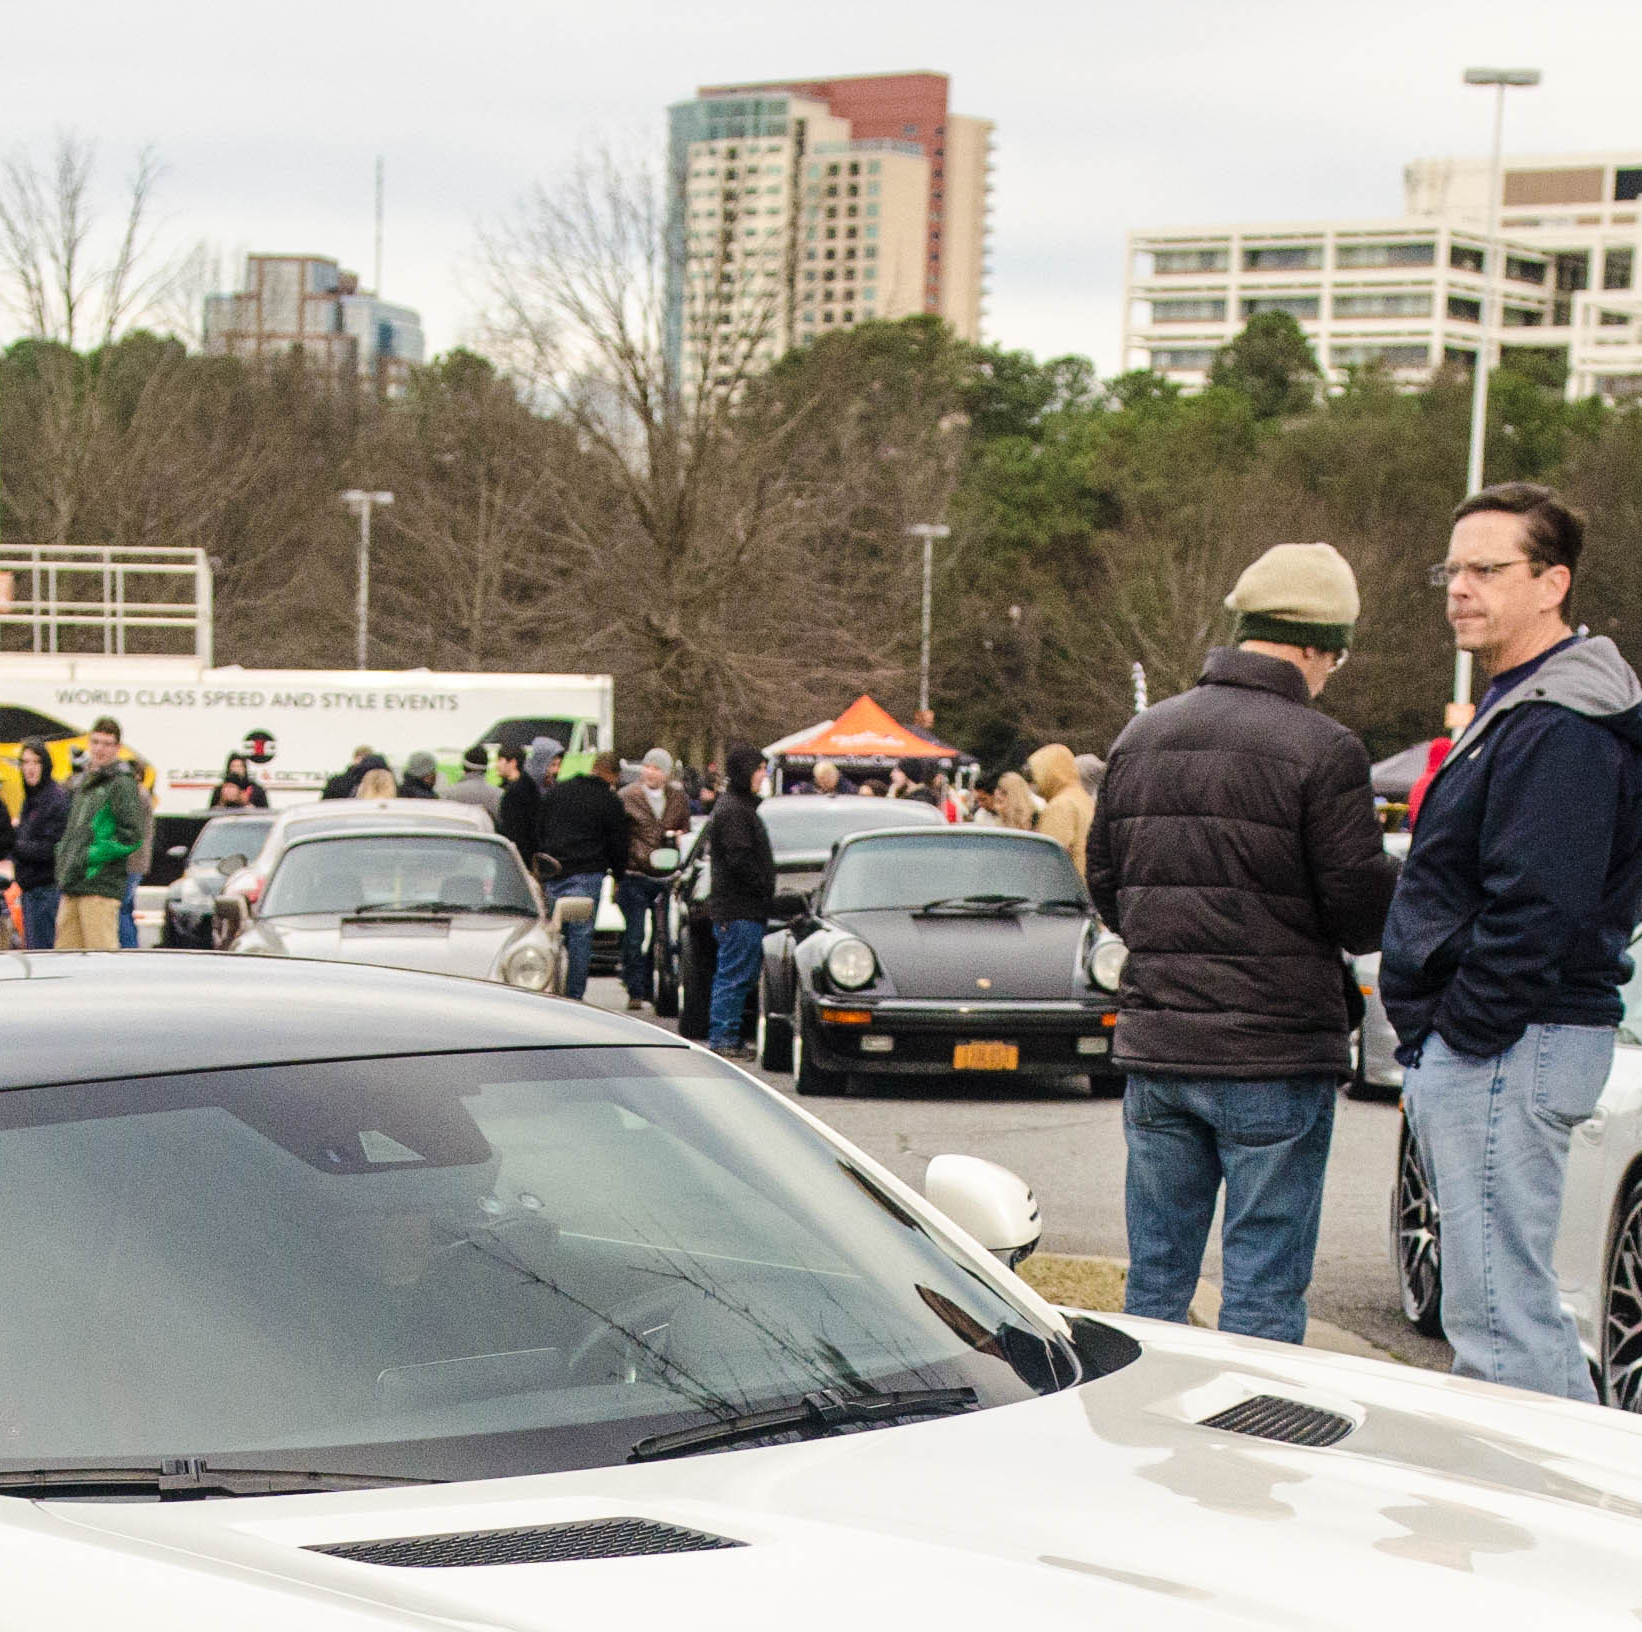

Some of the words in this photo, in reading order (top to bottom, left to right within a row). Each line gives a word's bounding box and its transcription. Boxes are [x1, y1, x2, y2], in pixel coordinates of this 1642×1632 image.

[57, 688, 130, 706] WORLD
[135, 689, 195, 707] CLASS
[203, 690, 265, 708] SPEED
[270, 691, 315, 708] AND
[321, 692, 377, 709] STYLE
[384, 693, 459, 711] EVENTS
